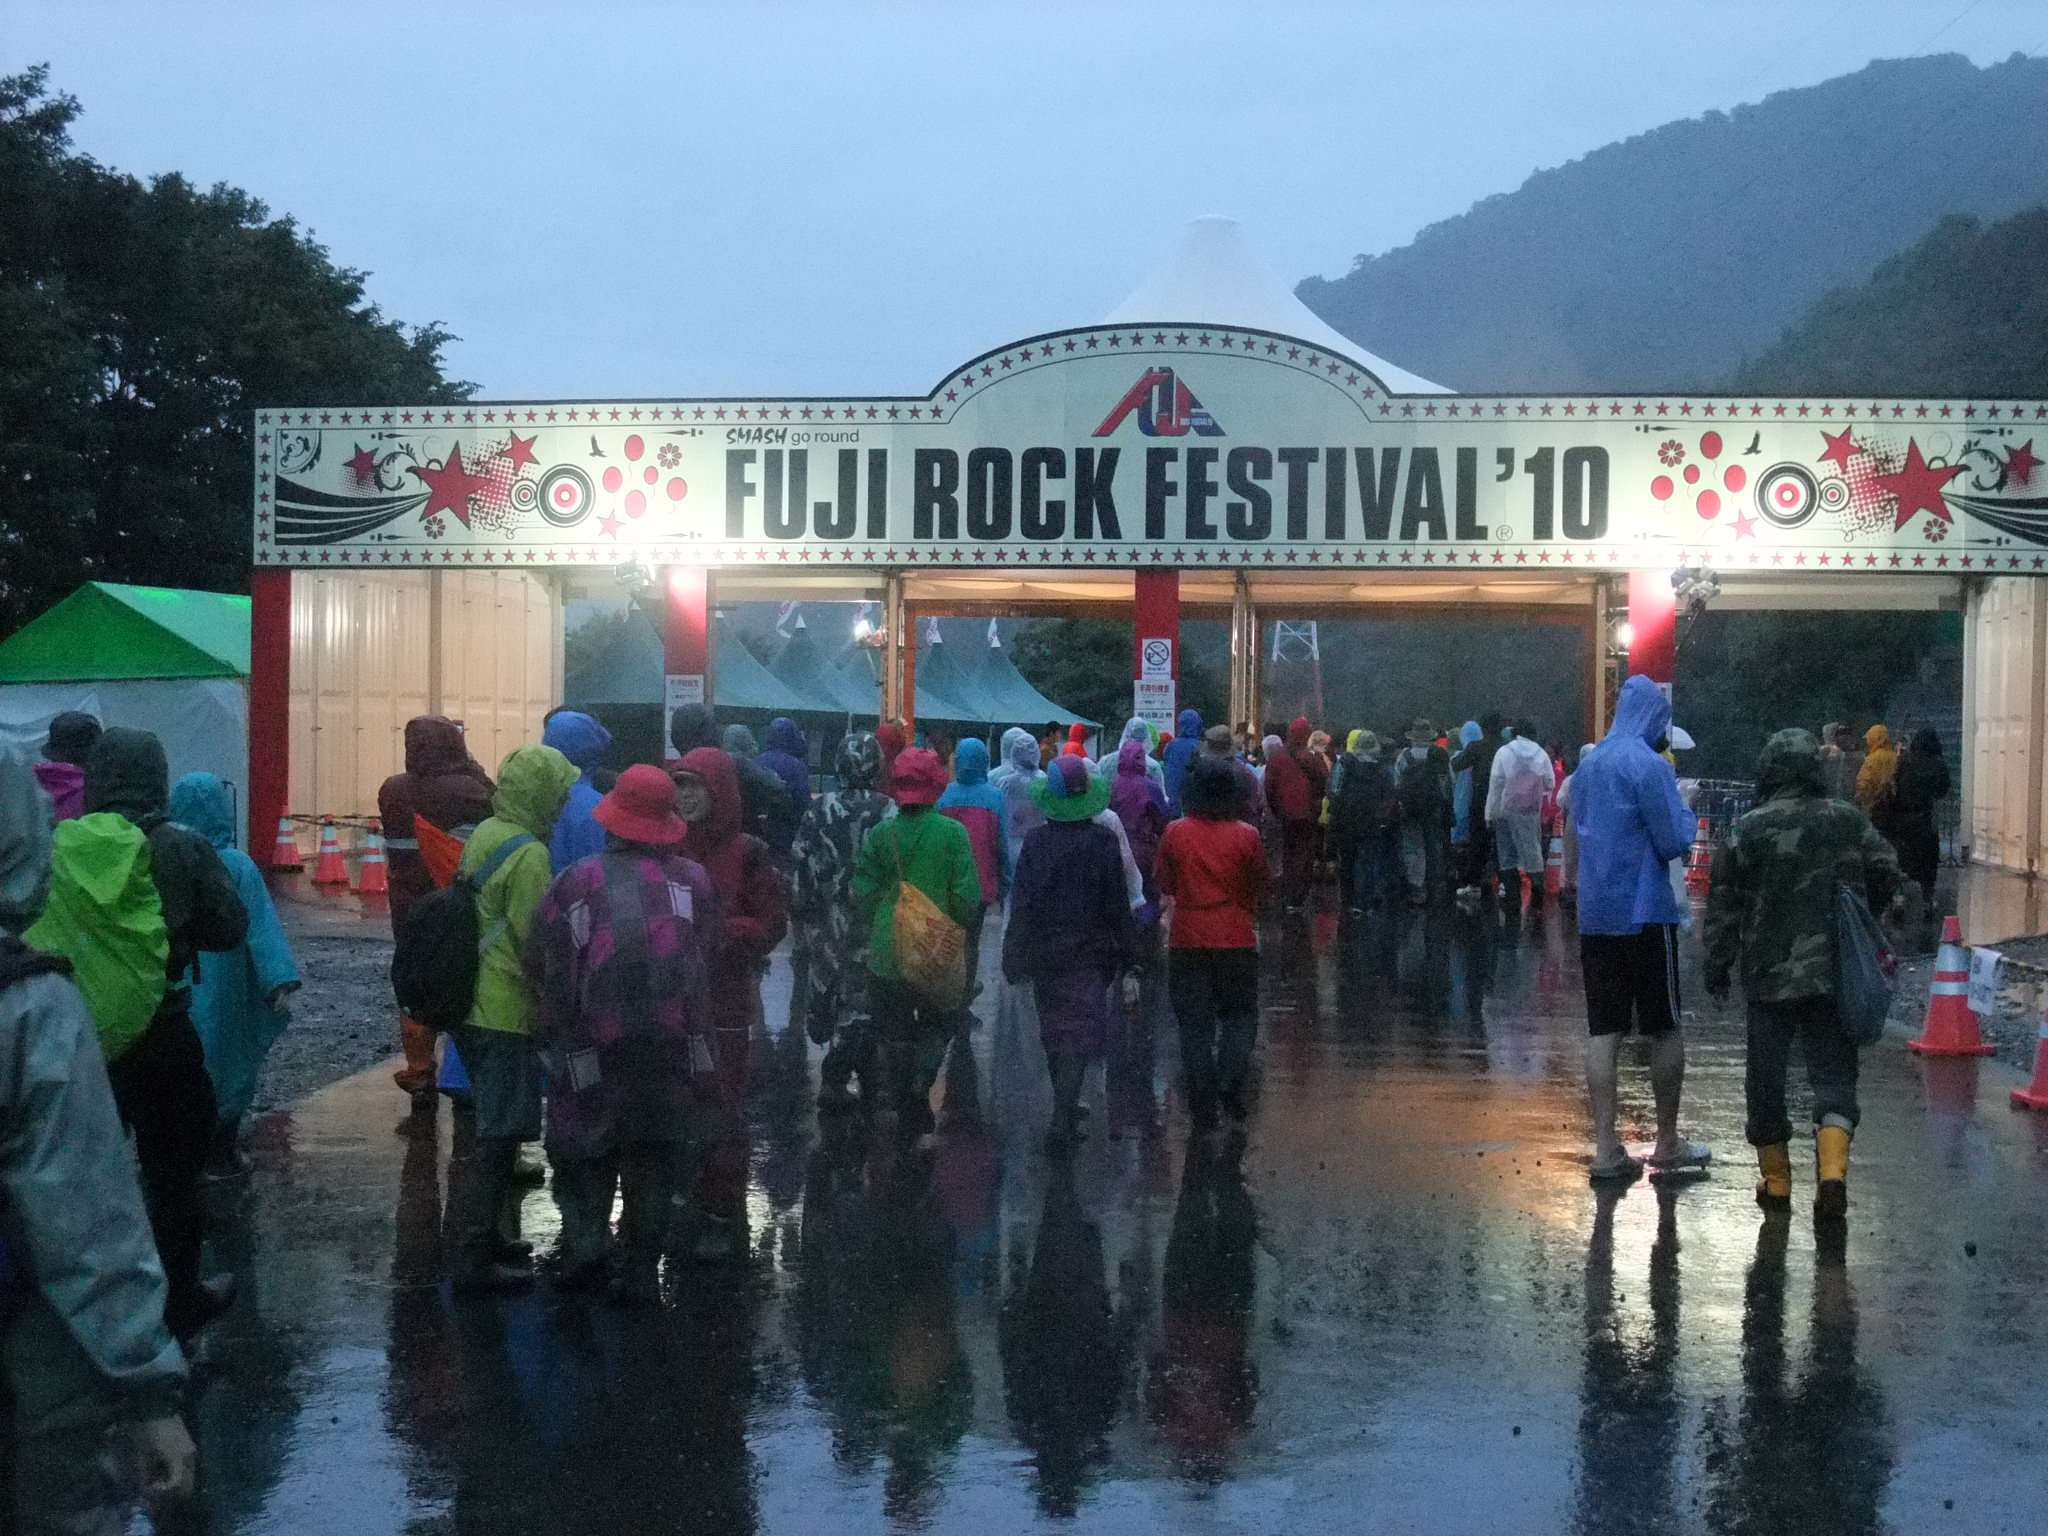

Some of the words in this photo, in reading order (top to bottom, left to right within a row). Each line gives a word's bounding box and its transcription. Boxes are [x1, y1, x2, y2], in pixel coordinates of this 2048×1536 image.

[726, 427, 788, 445] SMASH
[791, 432, 811, 446] go
[814, 429, 860, 443] round
[725, 448, 887, 540] FUJI
[913, 447, 1123, 541] ROCK
